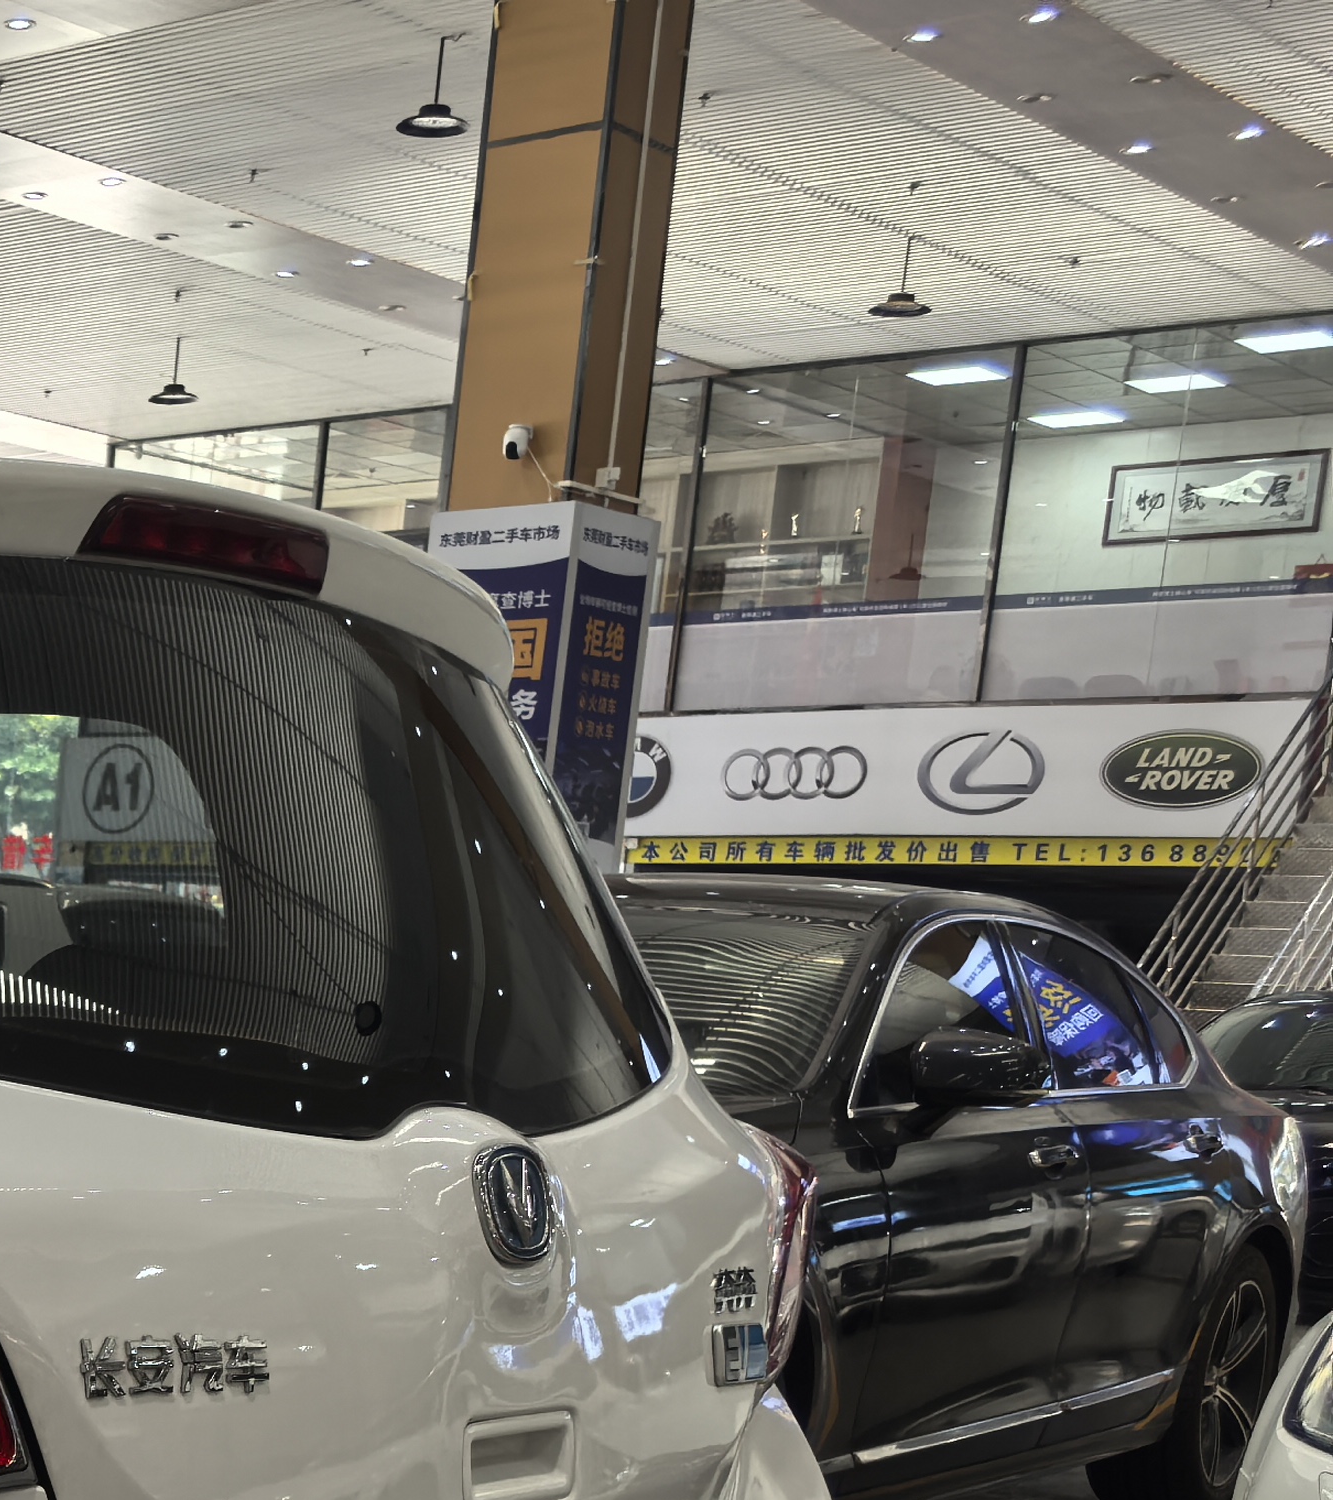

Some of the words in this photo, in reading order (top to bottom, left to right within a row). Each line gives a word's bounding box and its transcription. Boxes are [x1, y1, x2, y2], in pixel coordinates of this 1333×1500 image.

[438, 524, 561, 549] 东莞财盈二手车市场
[582, 526, 650, 557] 东莞财盈二手车市场
[583, 617, 625, 663] 拒绝
[590, 668, 621, 690] 事故车
[586, 694, 618, 715] 火烧车
[584, 719, 615, 740] 泡水车
[1136, 746, 1213, 769] LAND
[91, 761, 144, 813] A1
[1138, 769, 1235, 791] ROVER
[640, 840, 992, 863] 本公司所有车辆批发价出售
[79, 1331, 270, 1400] 长安汽车
